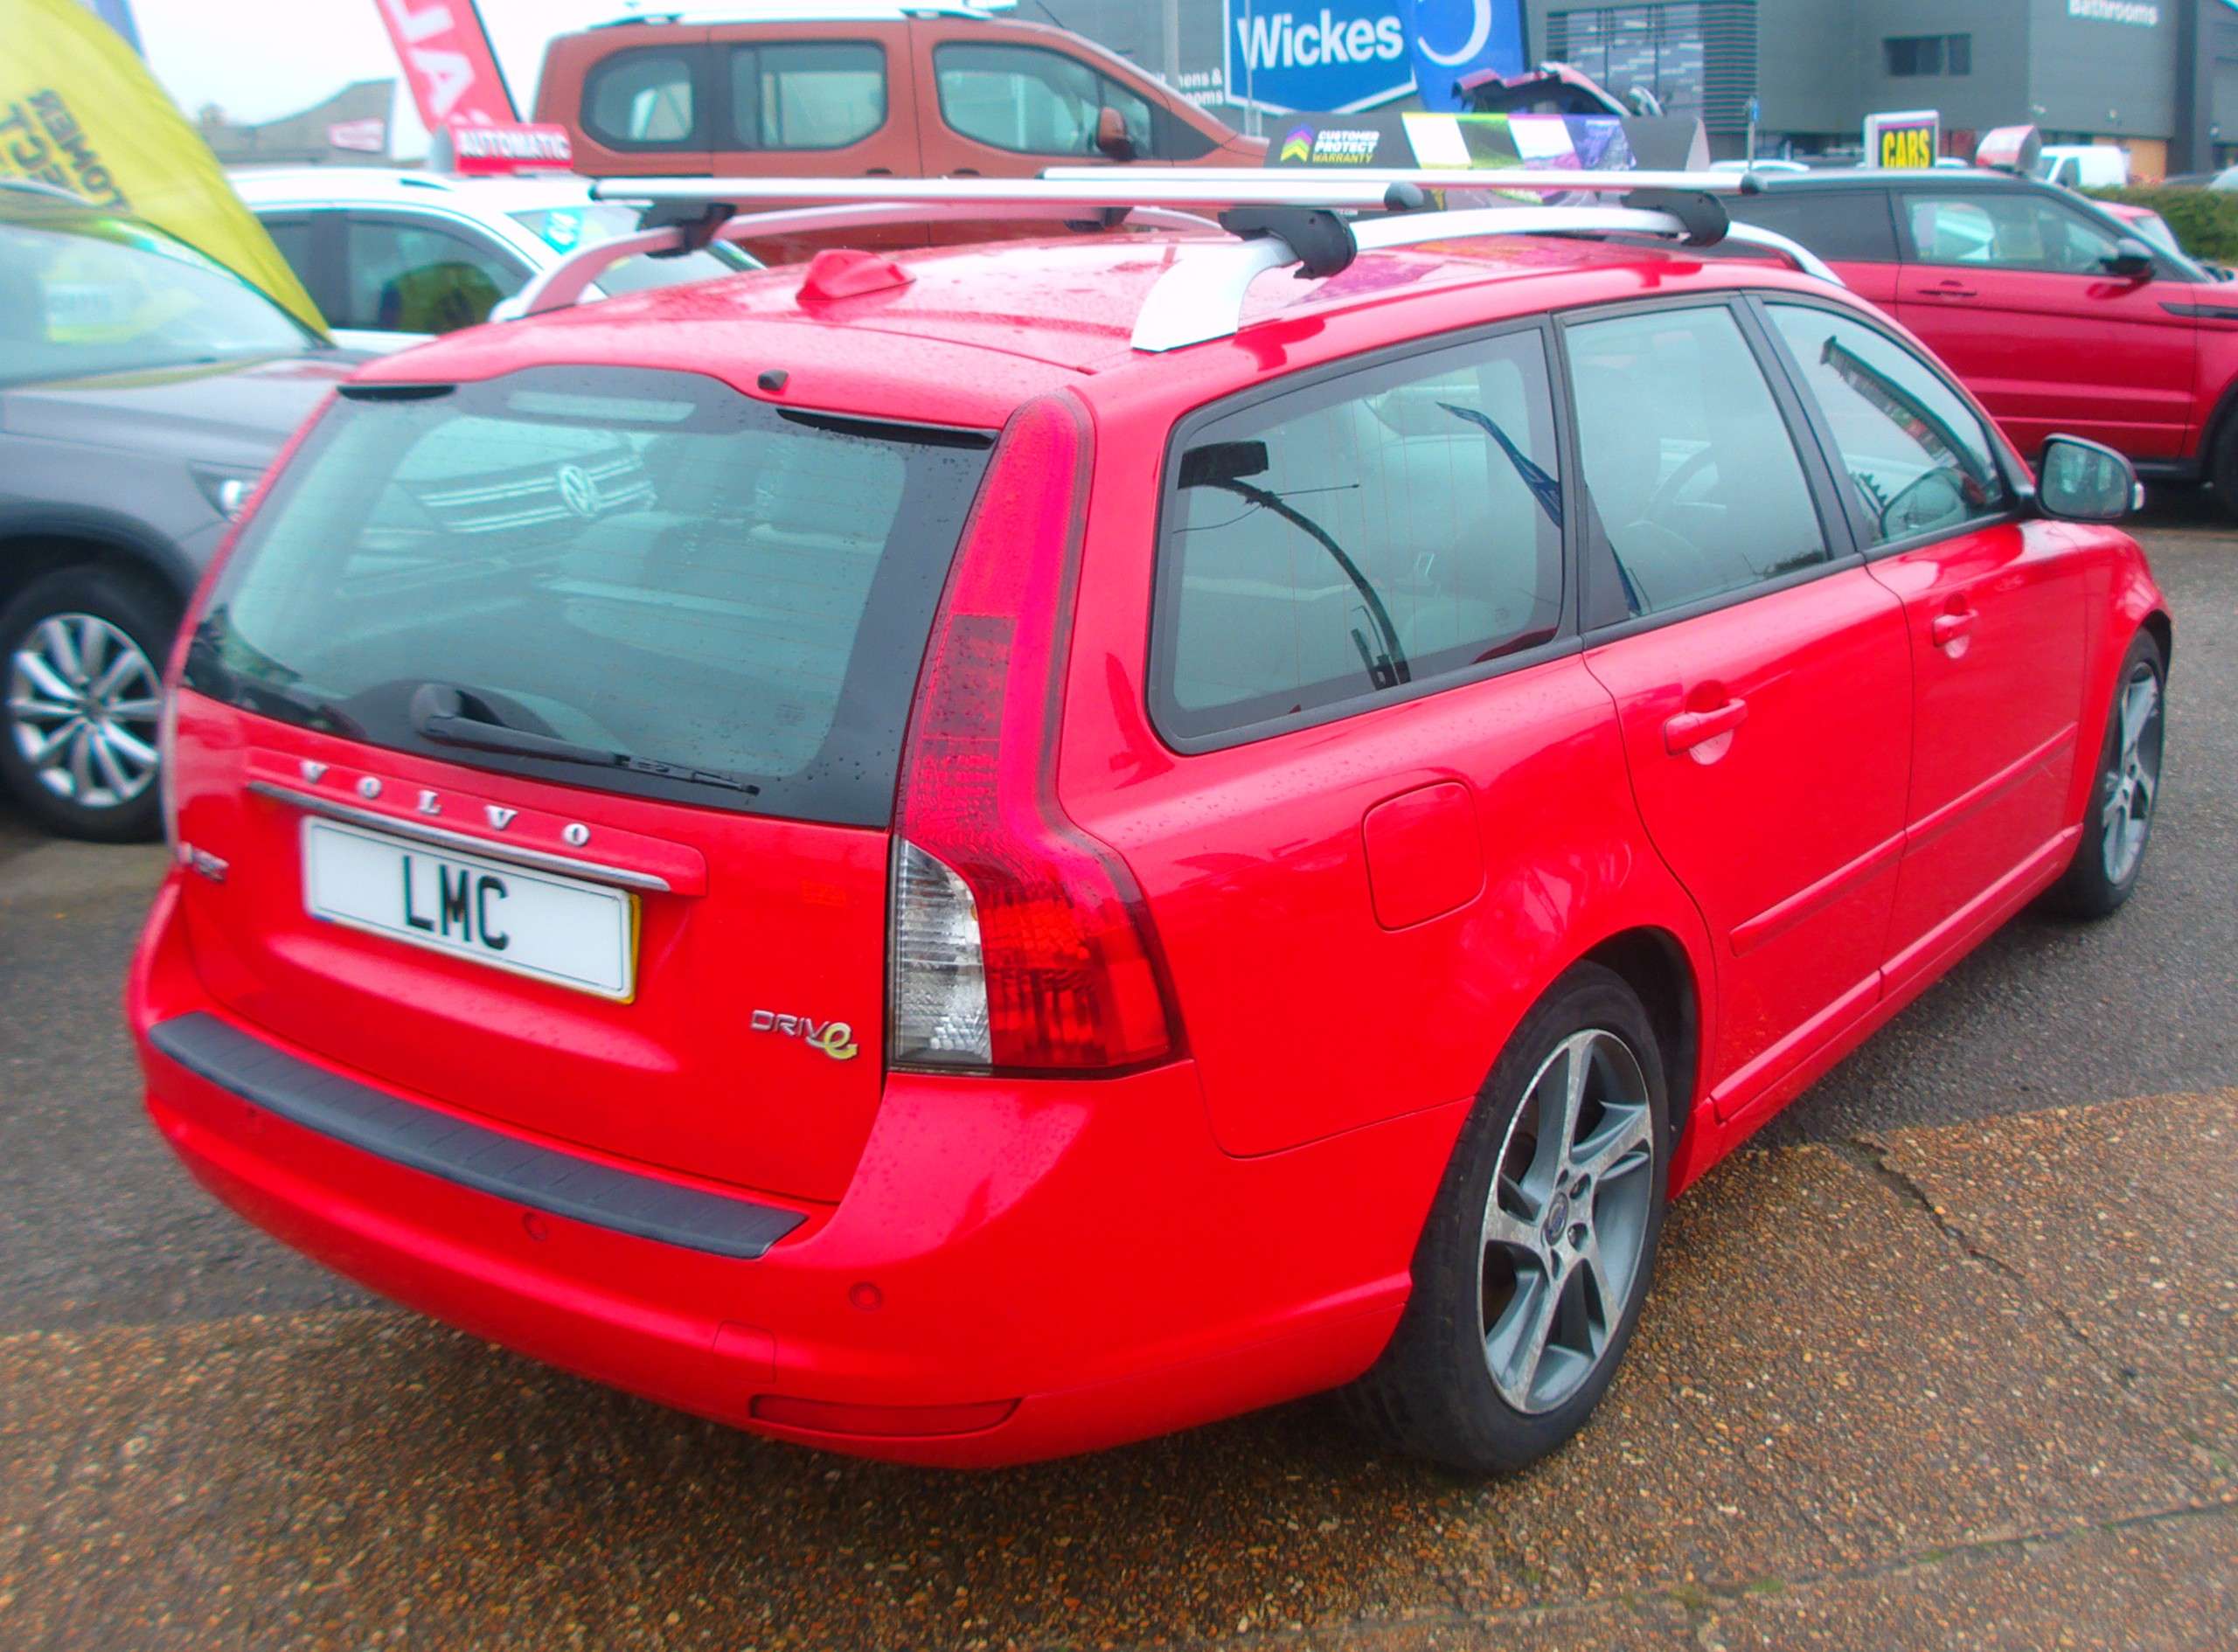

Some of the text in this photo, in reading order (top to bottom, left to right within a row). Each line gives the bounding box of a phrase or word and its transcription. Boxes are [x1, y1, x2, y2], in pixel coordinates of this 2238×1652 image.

[1237, 9, 1404, 70] Wickes
[457, 131, 572, 160] AUTOMATIC
[1315, 140, 1377, 154] PROTECT
[1318, 129, 1380, 142] CUSTOMER
[1883, 128, 1931, 168] CARS
[1312, 153, 1373, 163] WARRANTY
[300, 759, 591, 848] VOLVO
[403, 855, 510, 951] LMC
